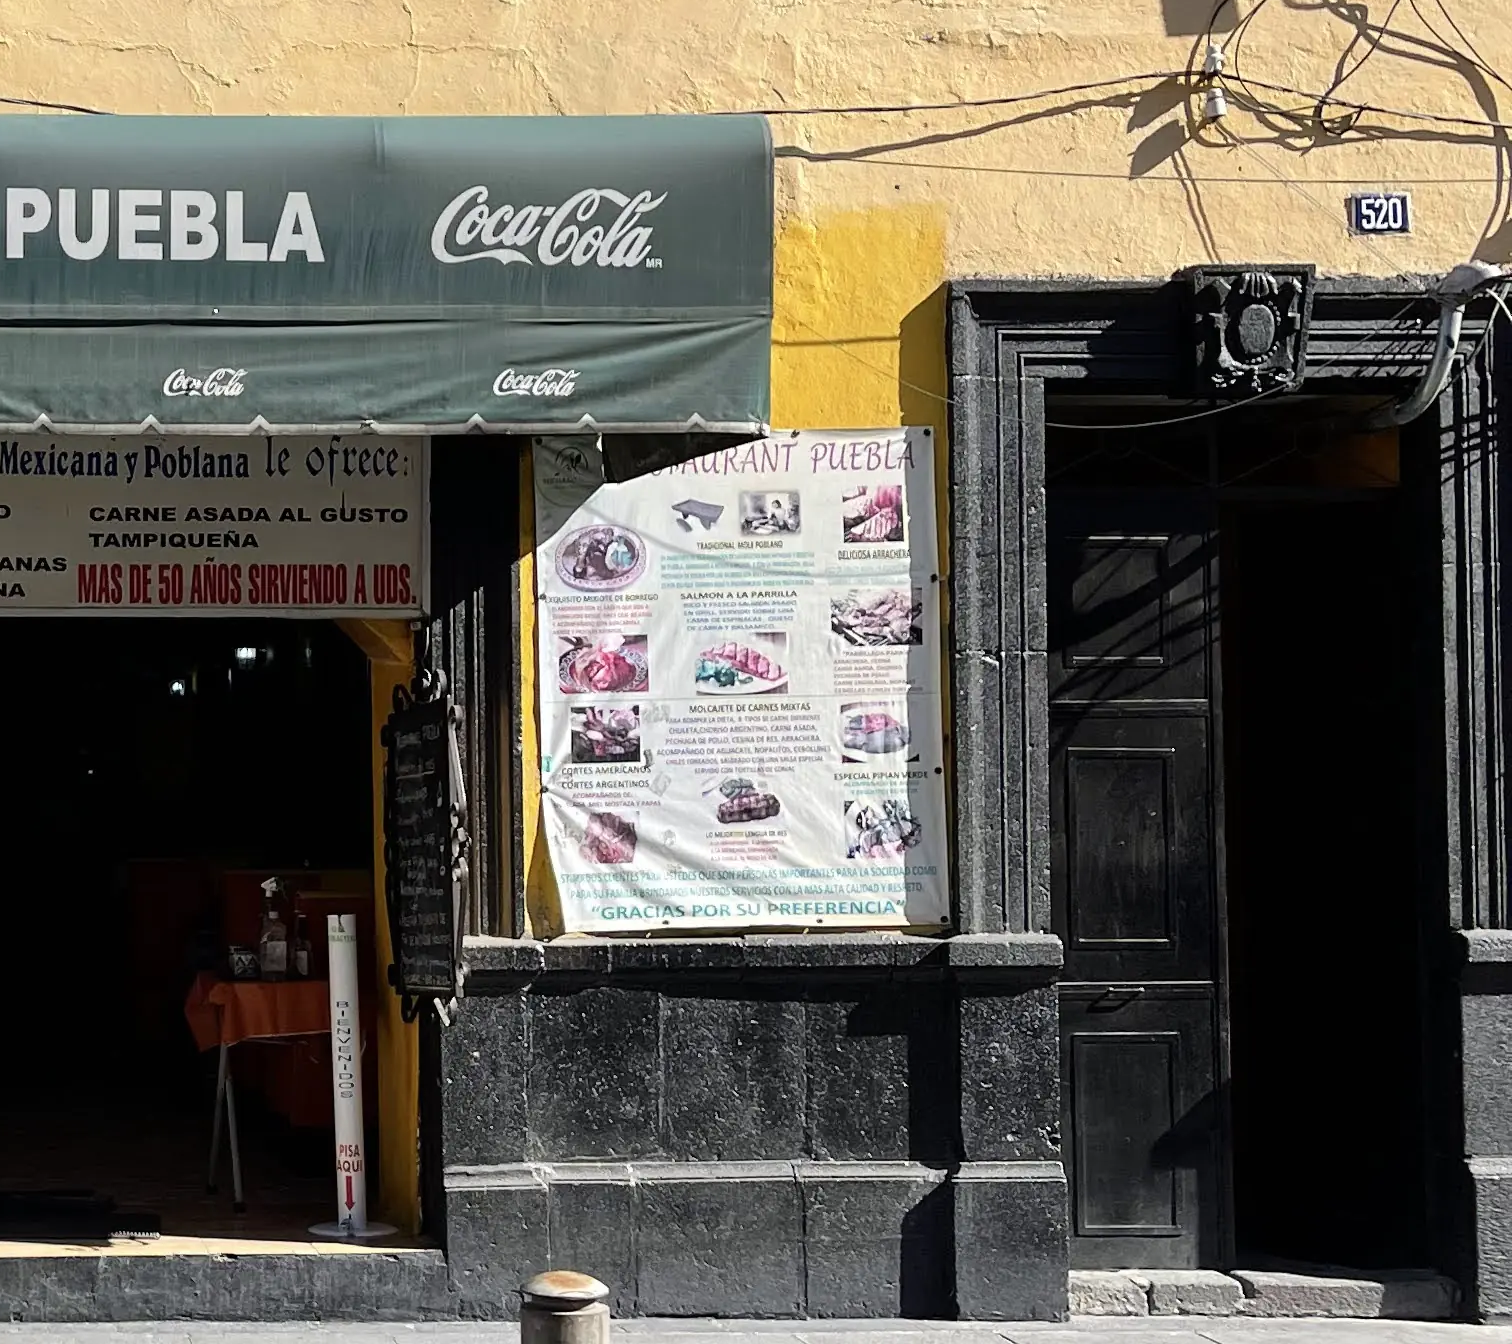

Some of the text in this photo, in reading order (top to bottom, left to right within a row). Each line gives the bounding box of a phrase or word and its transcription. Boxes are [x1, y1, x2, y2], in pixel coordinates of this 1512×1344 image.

[1361, 198, 1402, 230] 520
[6, 187, 325, 263] PUEBLA
[431, 185, 668, 267] Coca-Cola
[646, 258, 663, 269] MR
[0, 440, 118, 478] Mexicana
[126, 450, 139, 484] y
[144, 445, 250, 479] Poblana
[265, 435, 291, 477] le
[305, 435, 409, 487] ofrece:
[651, 440, 915, 476] AURANT PUEBLA
[89, 506, 408, 523] CARNE ASADA AL GUSTO
[89, 530, 259, 548] TAMPIQUEÑA
[838, 550, 871, 560] DELICIOSA
[78, 557, 417, 605] MAS DE 50 AÑOS SIRVIENDO A UDS.
[680, 592, 724, 600] SALMON
[751, 590, 798, 598] PARRILLA
[689, 702, 811, 713] MOLCAJETE DE CARNES MIXTAS
[562, 765, 652, 776] CORTES AMERICANOS
[834, 772, 870, 780] ESPECIAL
[901, 771, 928, 779] VERDE
[562, 780, 649, 789] CORTES ARGENTINOS
[699, 870, 717, 880] QUE
[718, 870, 734, 880] SON
[836, 867, 858, 875] PARA
[860, 867, 869, 876] LA
[869, 866, 910, 876] SOCIEDAD
[912, 866, 937, 875] COMO
[732, 886, 771, 895] SERVICIOS
[774, 886, 791, 895] CON
[793, 885, 803, 895] LA
[804, 884, 823, 894] MAS
[824, 884, 845, 894] ALTA
[846, 883, 879, 893] CALIDAD
[692, 904, 731, 917] POR
[737, 903, 760, 916] SU
[336, 1000, 355, 1099] BIENVENIDOS
[336, 1144, 363, 1173] PISA AQUI
